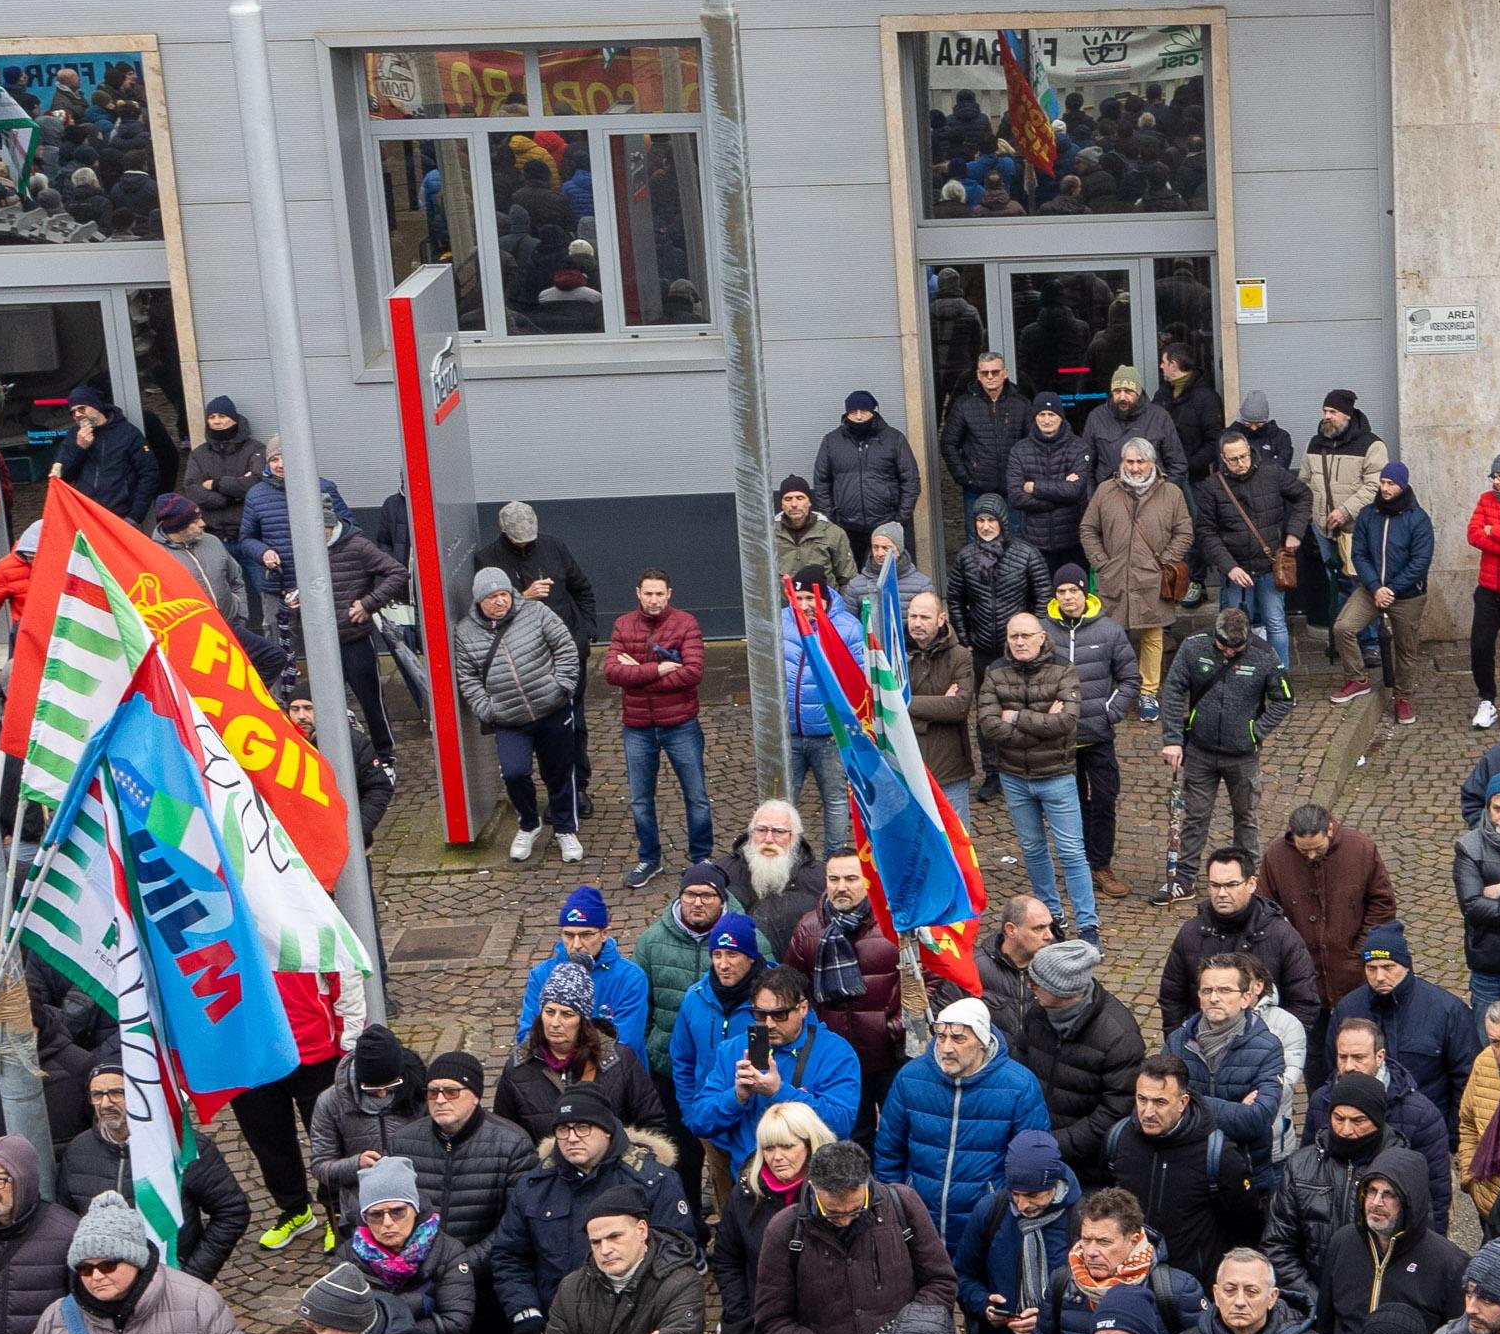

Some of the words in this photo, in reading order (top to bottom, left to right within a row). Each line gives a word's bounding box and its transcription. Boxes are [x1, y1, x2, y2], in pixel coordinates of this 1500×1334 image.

[1448, 310, 1475, 319] AREA
[190, 621, 284, 712] FIO
[127, 828, 243, 1025] UILM
